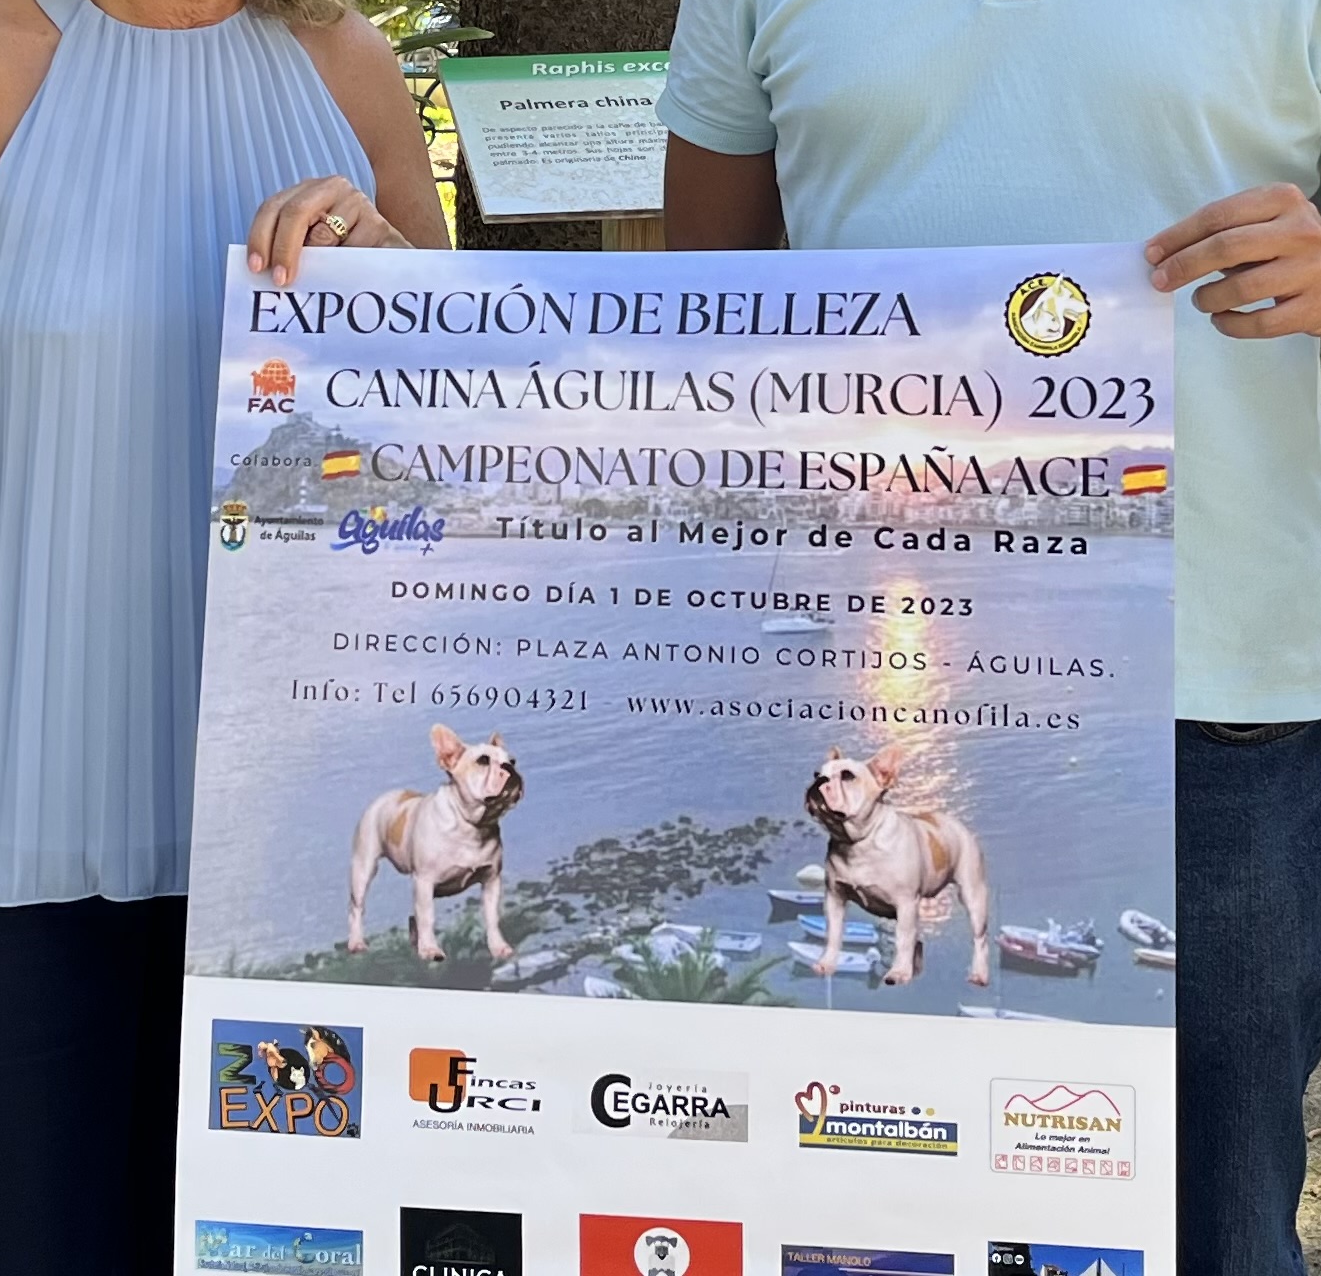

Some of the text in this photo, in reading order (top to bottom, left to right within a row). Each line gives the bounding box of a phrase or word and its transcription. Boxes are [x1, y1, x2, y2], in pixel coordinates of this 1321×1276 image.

[532, 61, 615, 77] Raphis
[500, 95, 653, 111] Palmera china
[249, 283, 921, 336] EXPOSICIÓN DE BELLEZA
[247, 398, 295, 414] FAC
[326, 360, 1155, 433] CANINA ÁGUILAS (MURCIA) 2023
[371, 443, 1110, 497] CAMPEONATO DE ESPAÑA ACE
[254, 516, 324, 527] Ayuntamiento
[260, 528, 316, 543] de Águilas
[496, 515, 1088, 555] Título al Mejor de Cada Raza
[391, 581, 974, 616] DOMINGO DÍA 1 DE OCTUBRE DE 2023
[333, 632, 502, 655] DIRECCIÓN:
[516, 639, 609, 660] PLAZA
[622, 642, 760, 664] ANTONIO
[776, 647, 927, 670] CORTIJOS
[967, 651, 1115, 678] ÁGUILAS.
[292, 678, 361, 702] Info:
[373, 680, 416, 704] Tel
[431, 683, 588, 712] 656904321
[626, 695, 1080, 730] www.asociacioncanofila.es
[448, 1056, 537, 1091] Fincas
[648, 1082, 708, 1094] Joyería
[429, 1083, 541, 1114] URCI
[591, 1073, 731, 1129] CEGARRA
[839, 1100, 906, 1115] pinturas
[219, 1086, 350, 1137] EXPO
[413, 1119, 535, 1135] ASESORÍA INMOBILIARIA
[649, 1117, 711, 1130] Relojería
[826, 1120, 948, 1141] montalbán
[1003, 1112, 1122, 1132] NUTRISAN
[870, 1139, 893, 1149] para
[1015, 1142, 1110, 1154] Alimentación Animal
[1049, 1134, 1076, 1143] mejor
[292, 1232, 362, 1265] Coral
[788, 1252, 871, 1267] TALLER MANOLO
